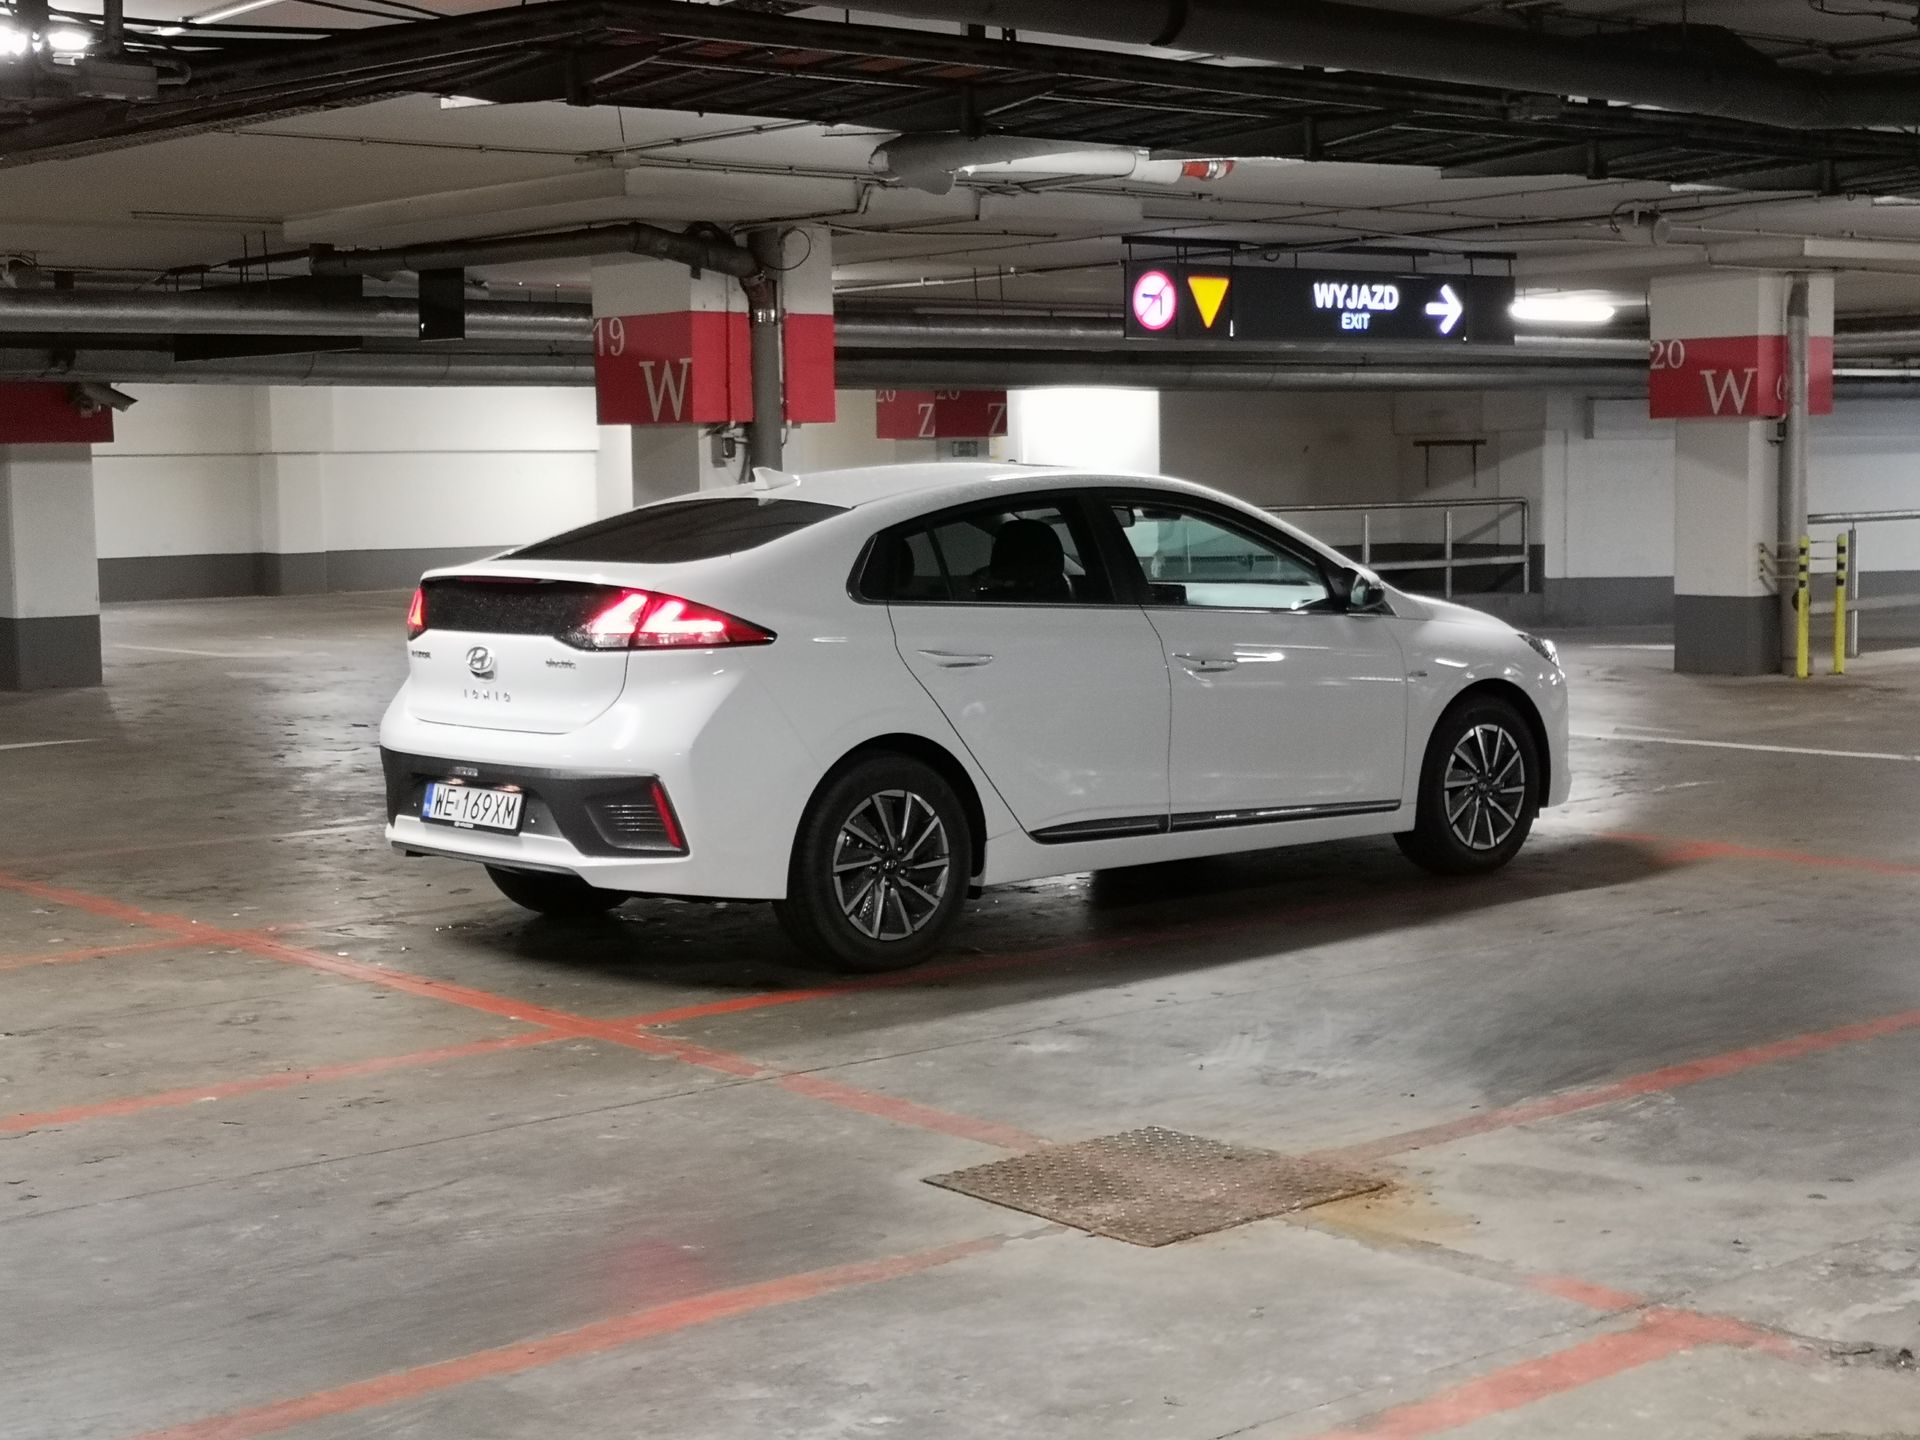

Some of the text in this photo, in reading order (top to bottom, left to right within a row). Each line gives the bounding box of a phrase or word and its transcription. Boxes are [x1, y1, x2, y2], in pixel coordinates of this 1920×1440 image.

[1313, 282, 1399, 311] WYJAZD
[593, 317, 625, 356] 19
[1341, 312, 1371, 330] EXIT
[1650, 339, 1685, 370] 20
[638, 358, 693, 422] W
[1700, 367, 1758, 415] W
[918, 403, 936, 437] Z
[987, 403, 1007, 436] Z
[434, 786, 457, 817] WE
[462, 789, 518, 826] 169XM
